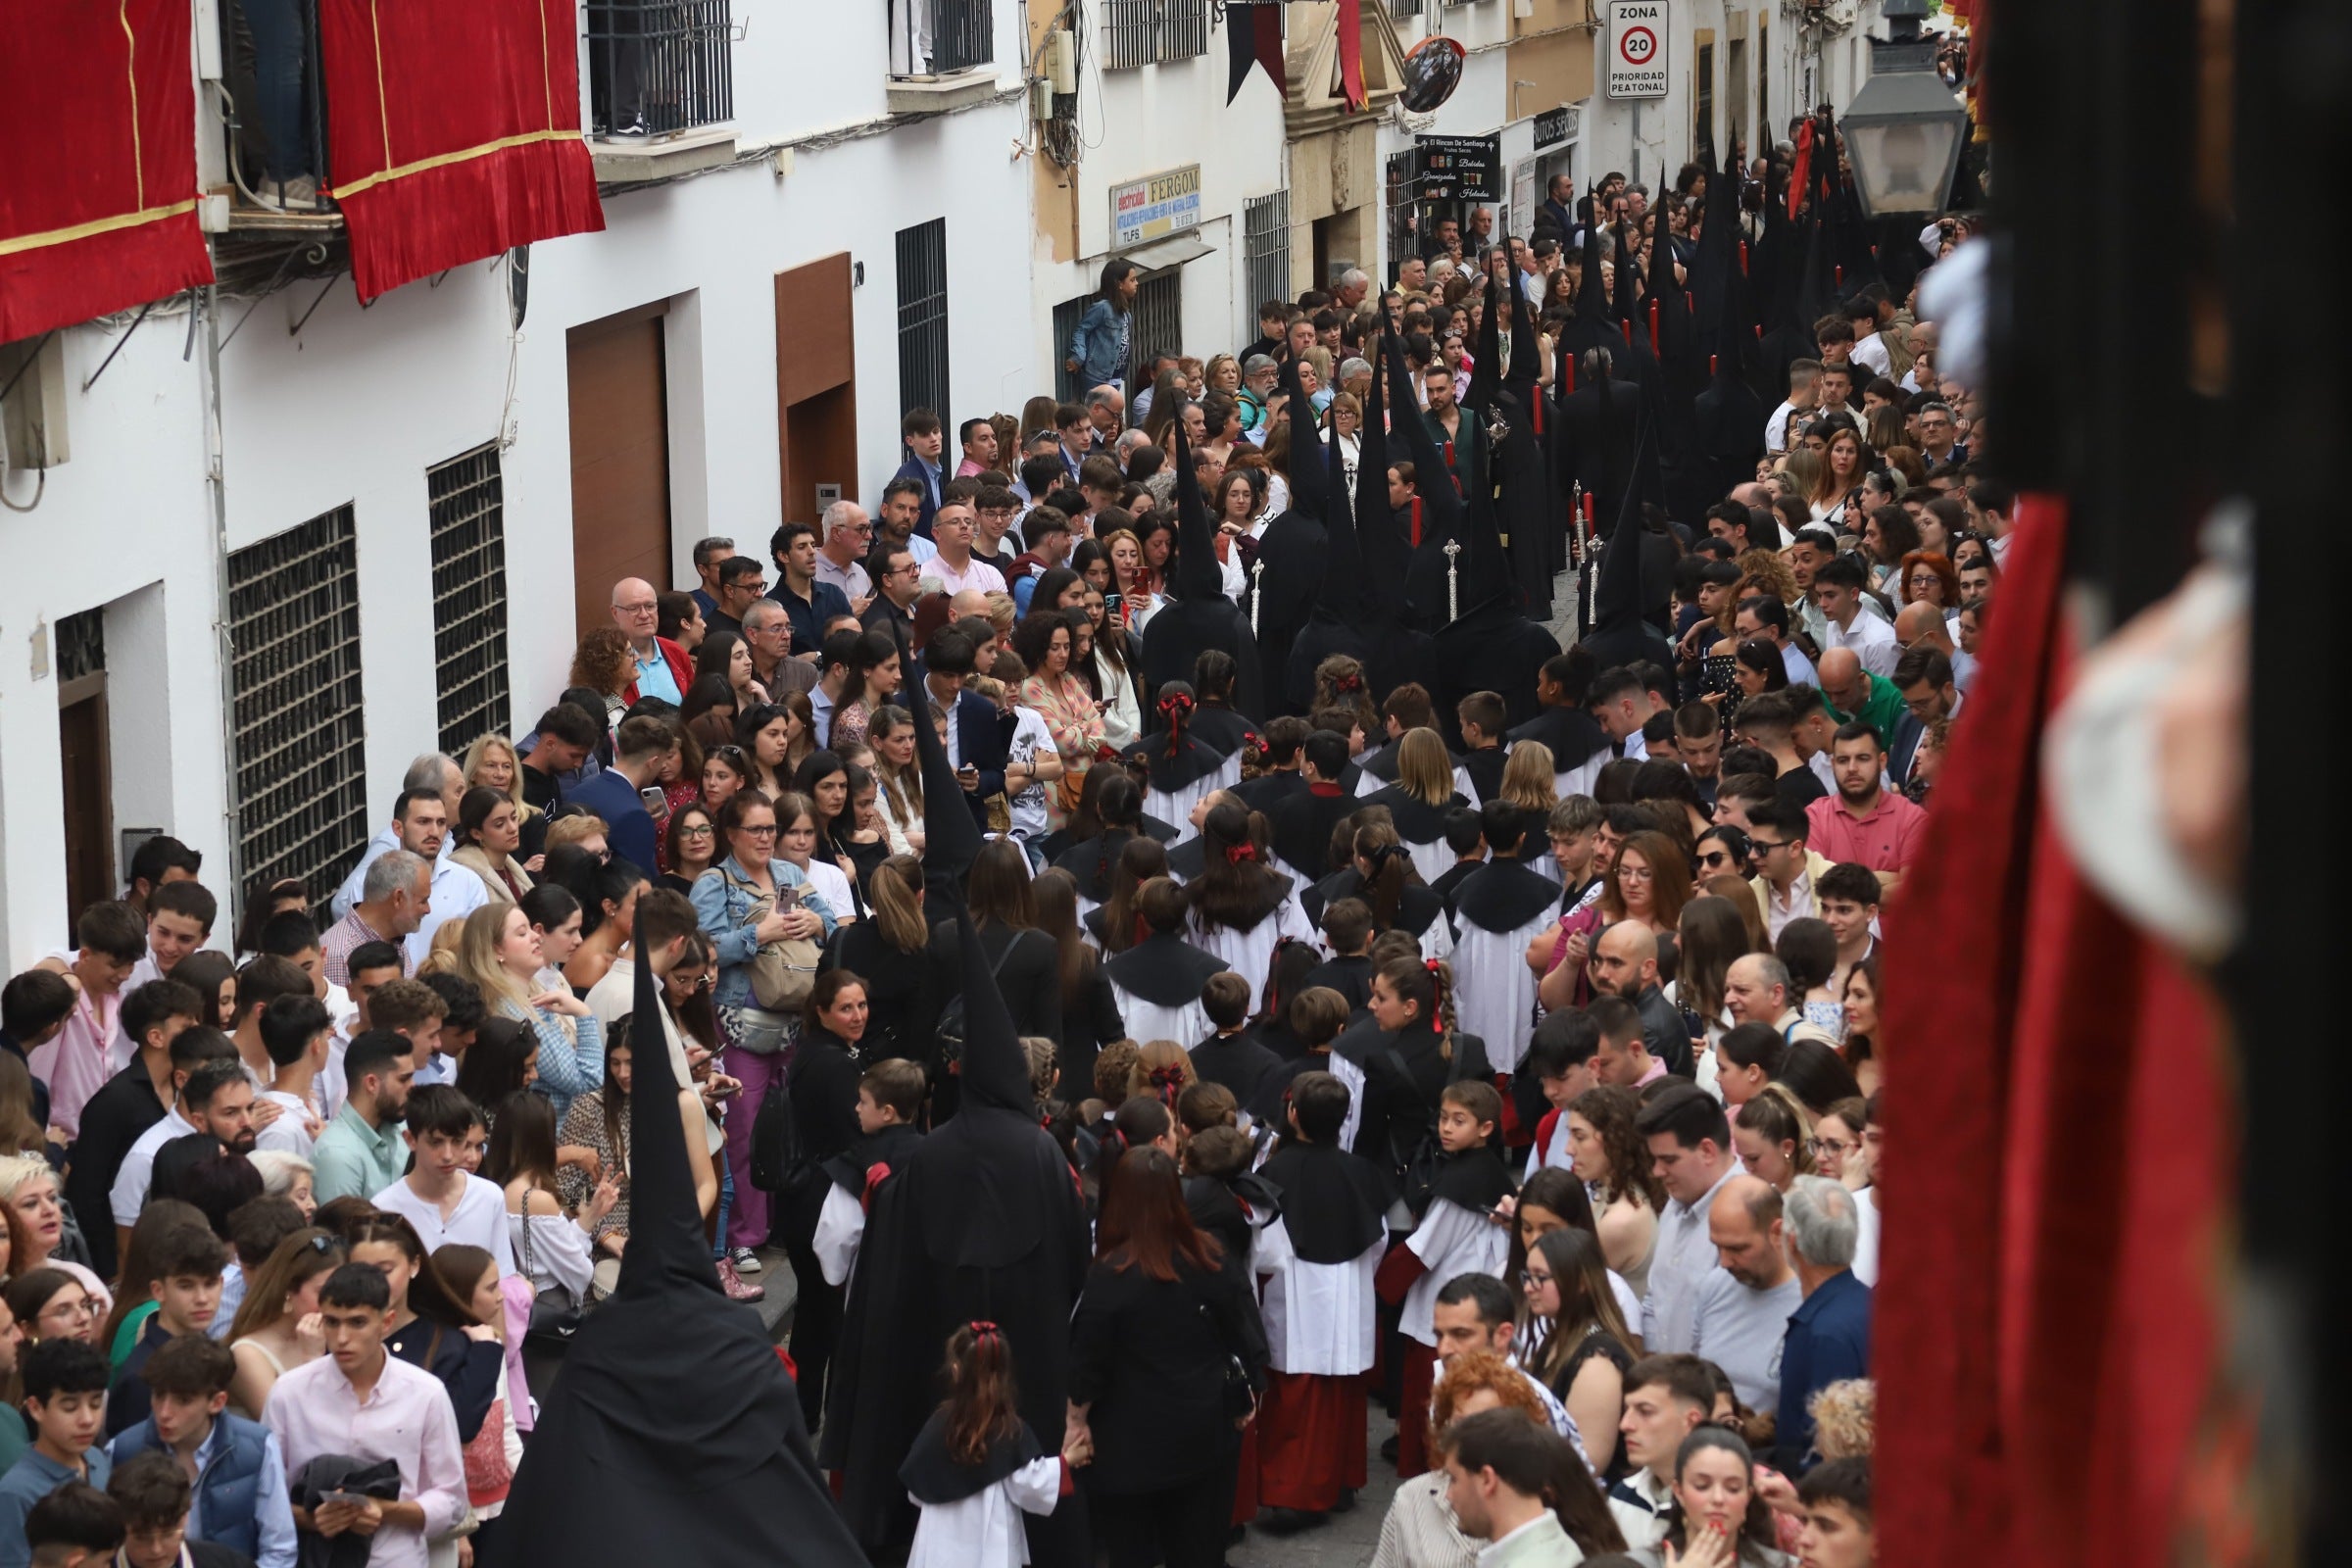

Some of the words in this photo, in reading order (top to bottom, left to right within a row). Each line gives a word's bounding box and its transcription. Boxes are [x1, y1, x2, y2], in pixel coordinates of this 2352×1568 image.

[1619, 7, 1658, 19] ZONA
[1629, 39, 1648, 52] 20
[1612, 72, 1665, 81] PRIORIDAD
[1611, 82, 1665, 92] PEATONAL
[1534, 118, 1554, 144] RUTOS
[1555, 111, 1578, 136] SECOS
[1462, 140, 1486, 149] Santiago
[1151, 171, 1199, 203] FERGOM
